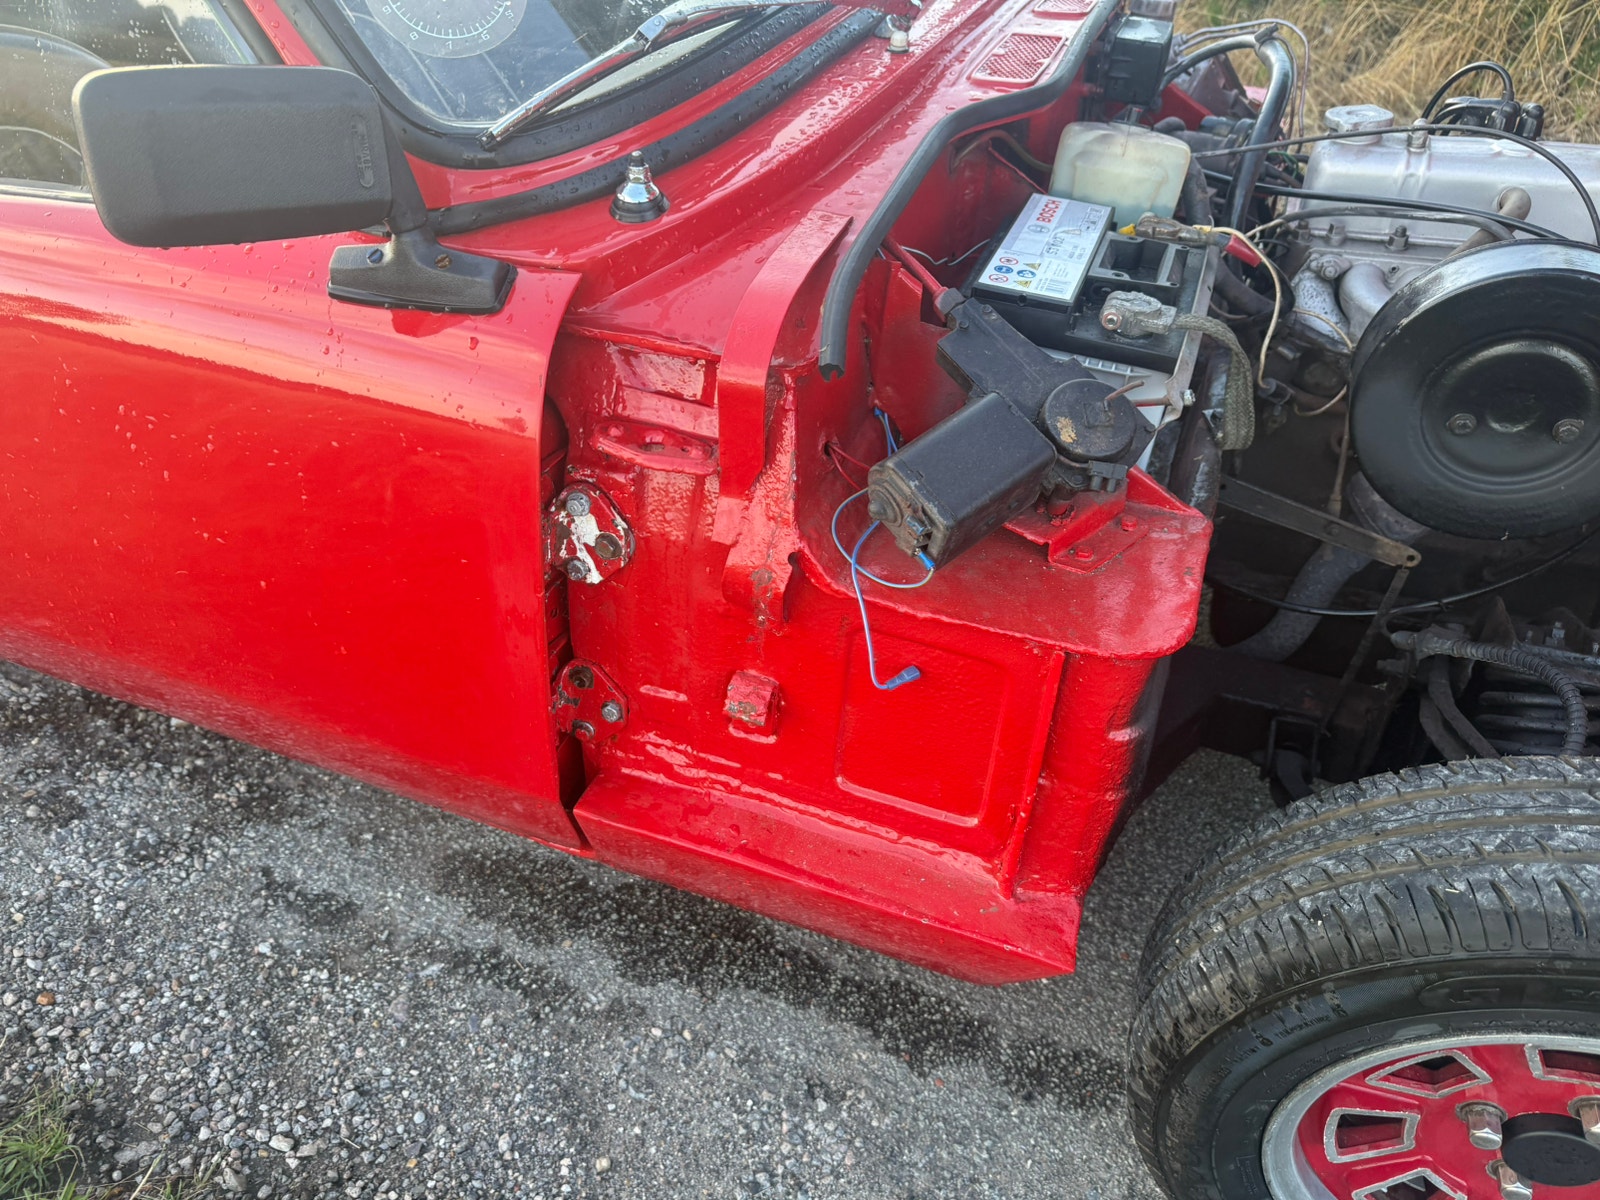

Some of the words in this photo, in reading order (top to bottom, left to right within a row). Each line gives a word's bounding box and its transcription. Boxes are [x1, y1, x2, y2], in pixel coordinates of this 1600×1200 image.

[409, 31, 419, 41] 8
[481, 30, 490, 40] 6
[445, 41, 452, 49] 7
[1036, 199, 1062, 223] BOSCH
